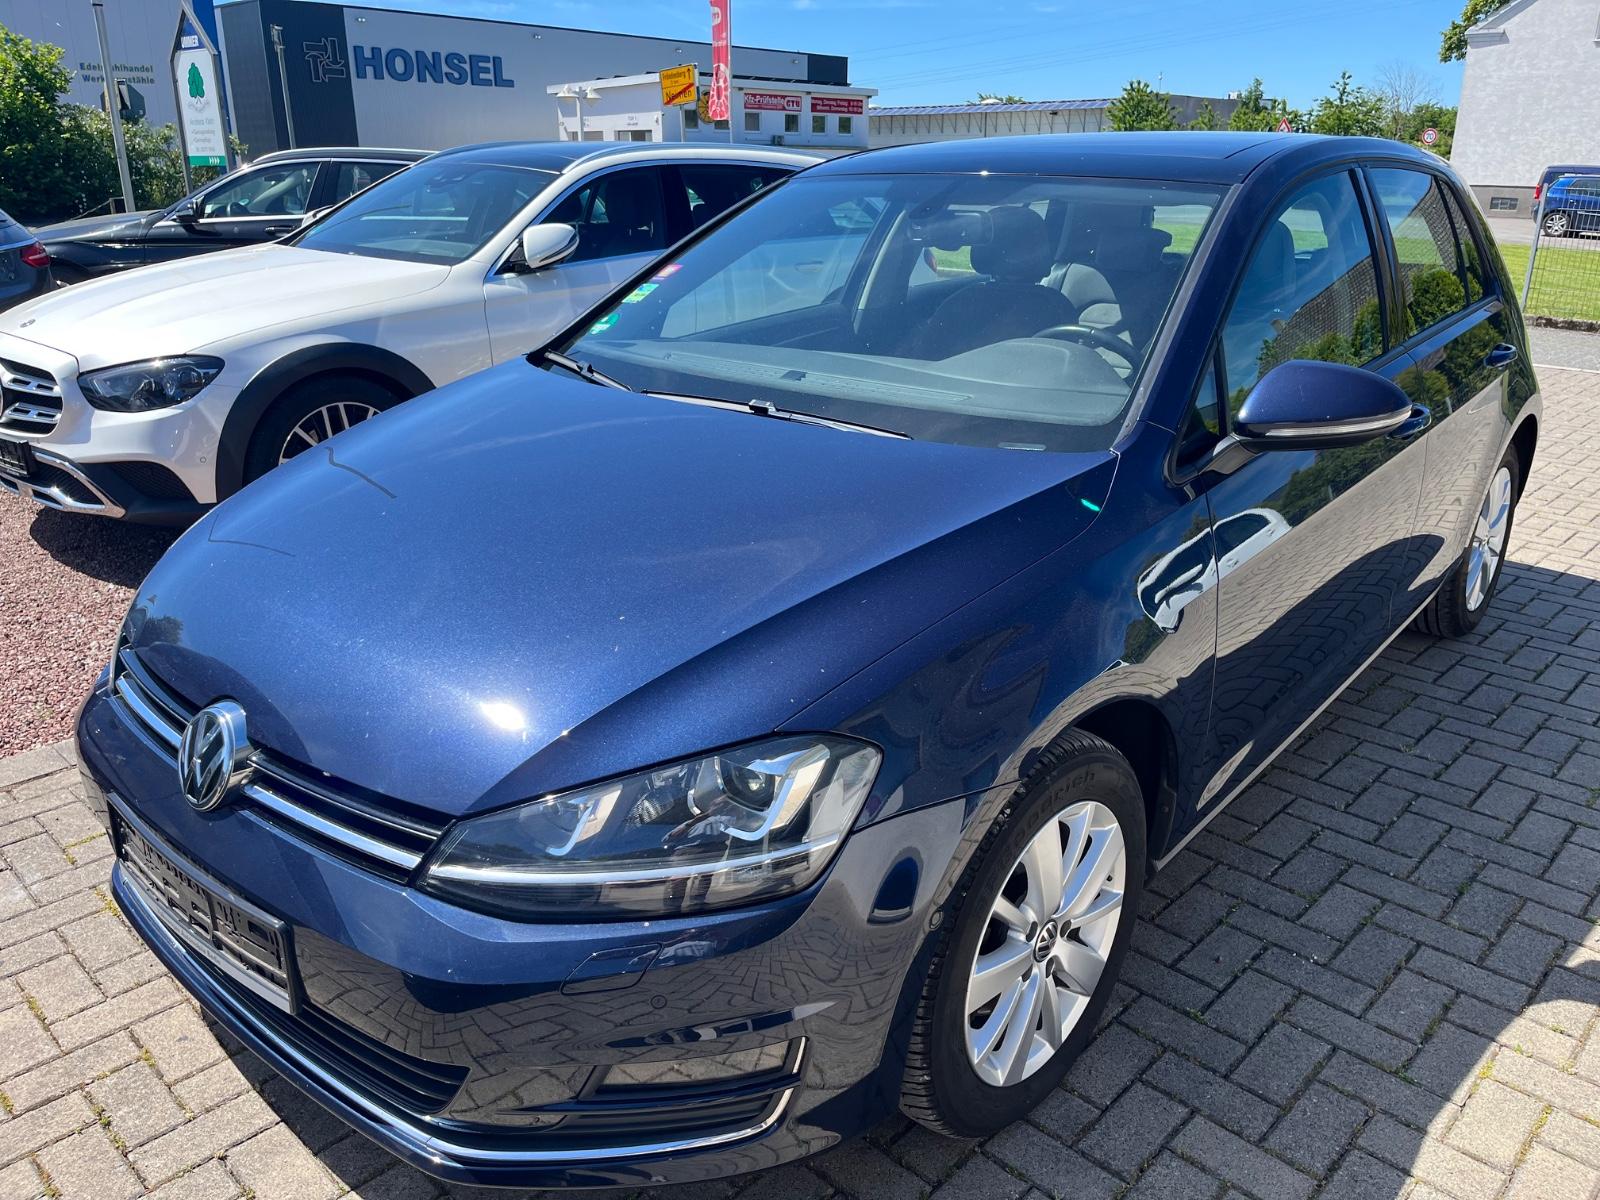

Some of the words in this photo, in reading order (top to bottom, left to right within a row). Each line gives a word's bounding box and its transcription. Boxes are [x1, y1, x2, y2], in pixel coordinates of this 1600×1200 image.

[79, 62, 154, 73] Edelhlhandel
[352, 45, 515, 88] HONSEL
[81, 74, 155, 84] Werkstähle
[1426, 132, 1434, 140] 70
